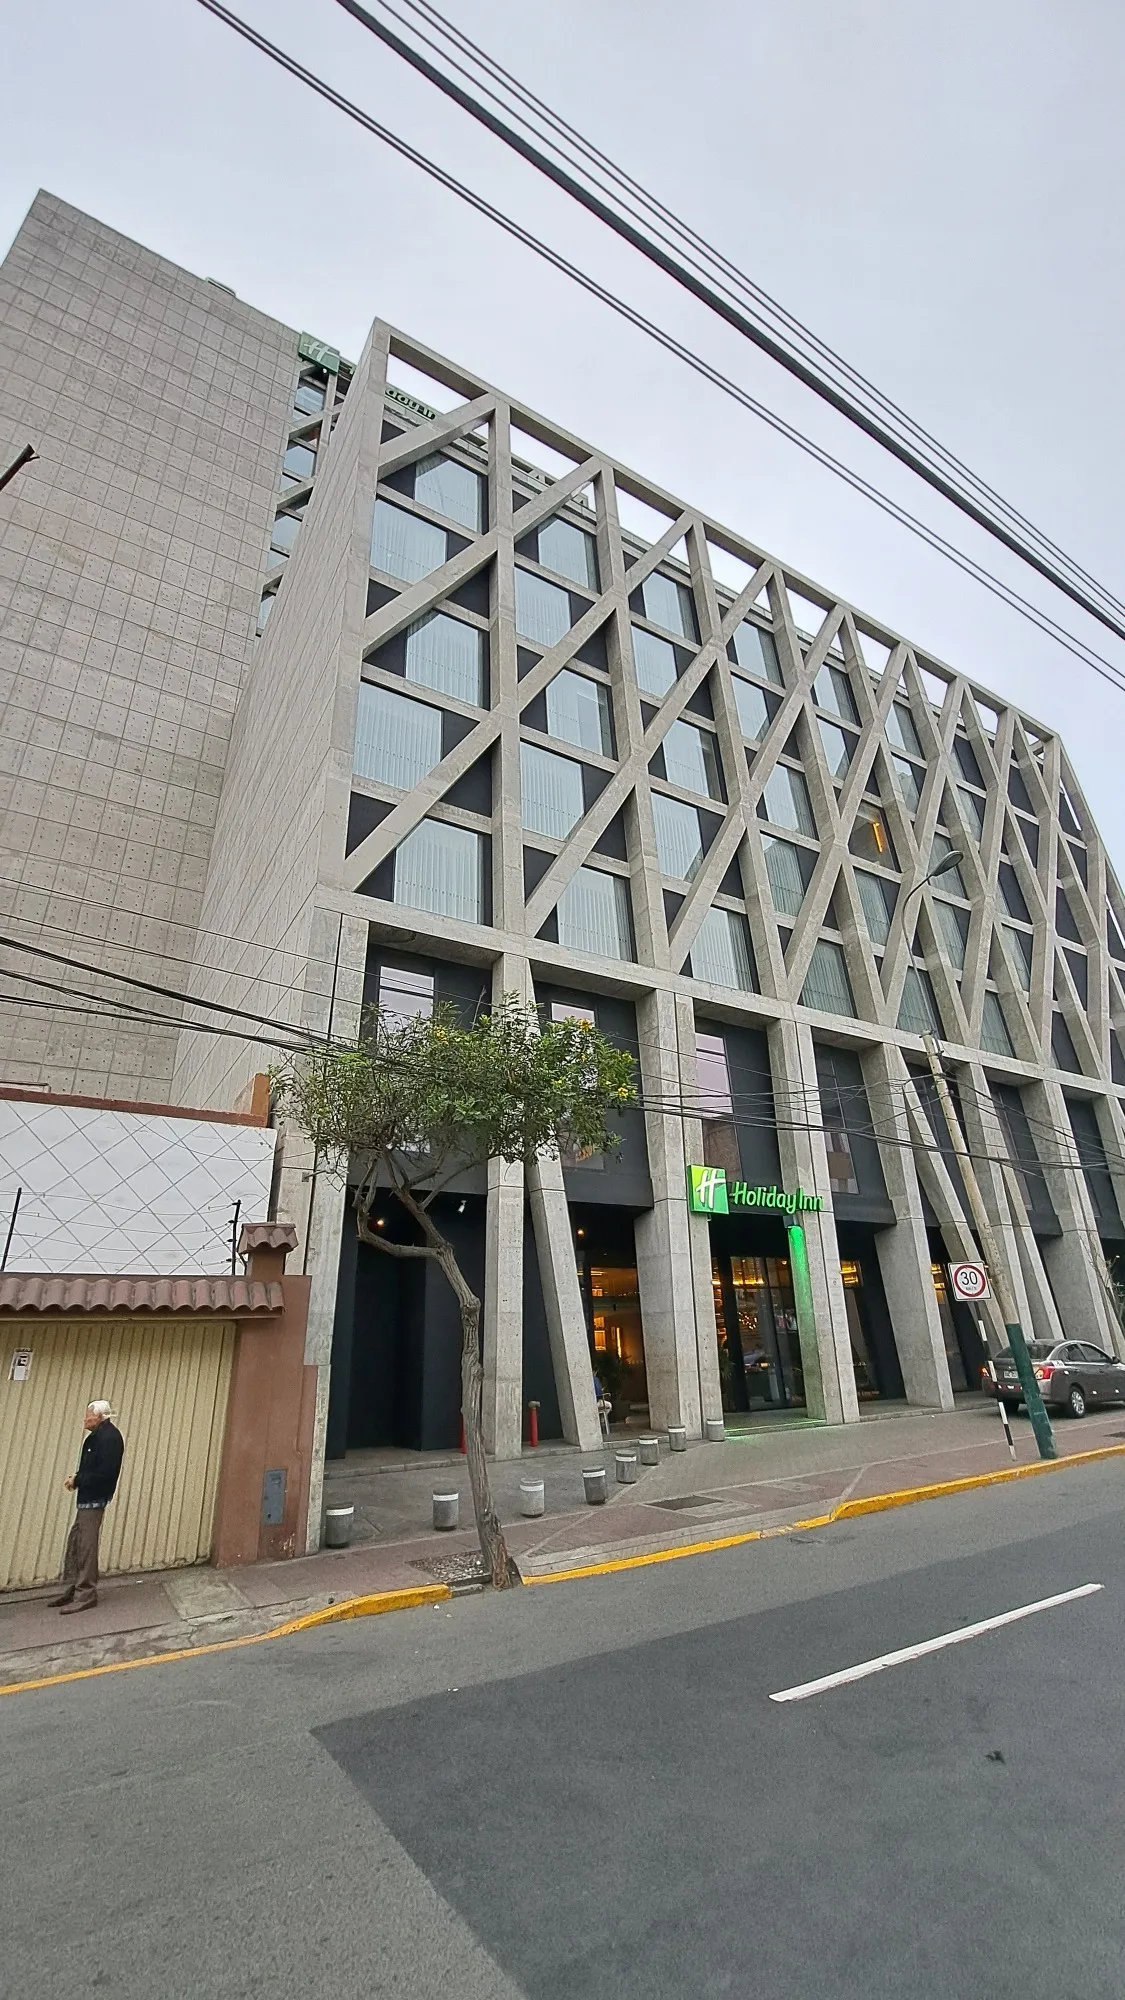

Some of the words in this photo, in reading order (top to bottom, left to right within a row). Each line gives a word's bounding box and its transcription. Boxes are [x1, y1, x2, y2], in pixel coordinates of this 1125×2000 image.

[730, 1181, 796, 1215] Holiday
[798, 1187, 824, 1211] Inn
[960, 1271, 978, 1286] 30
